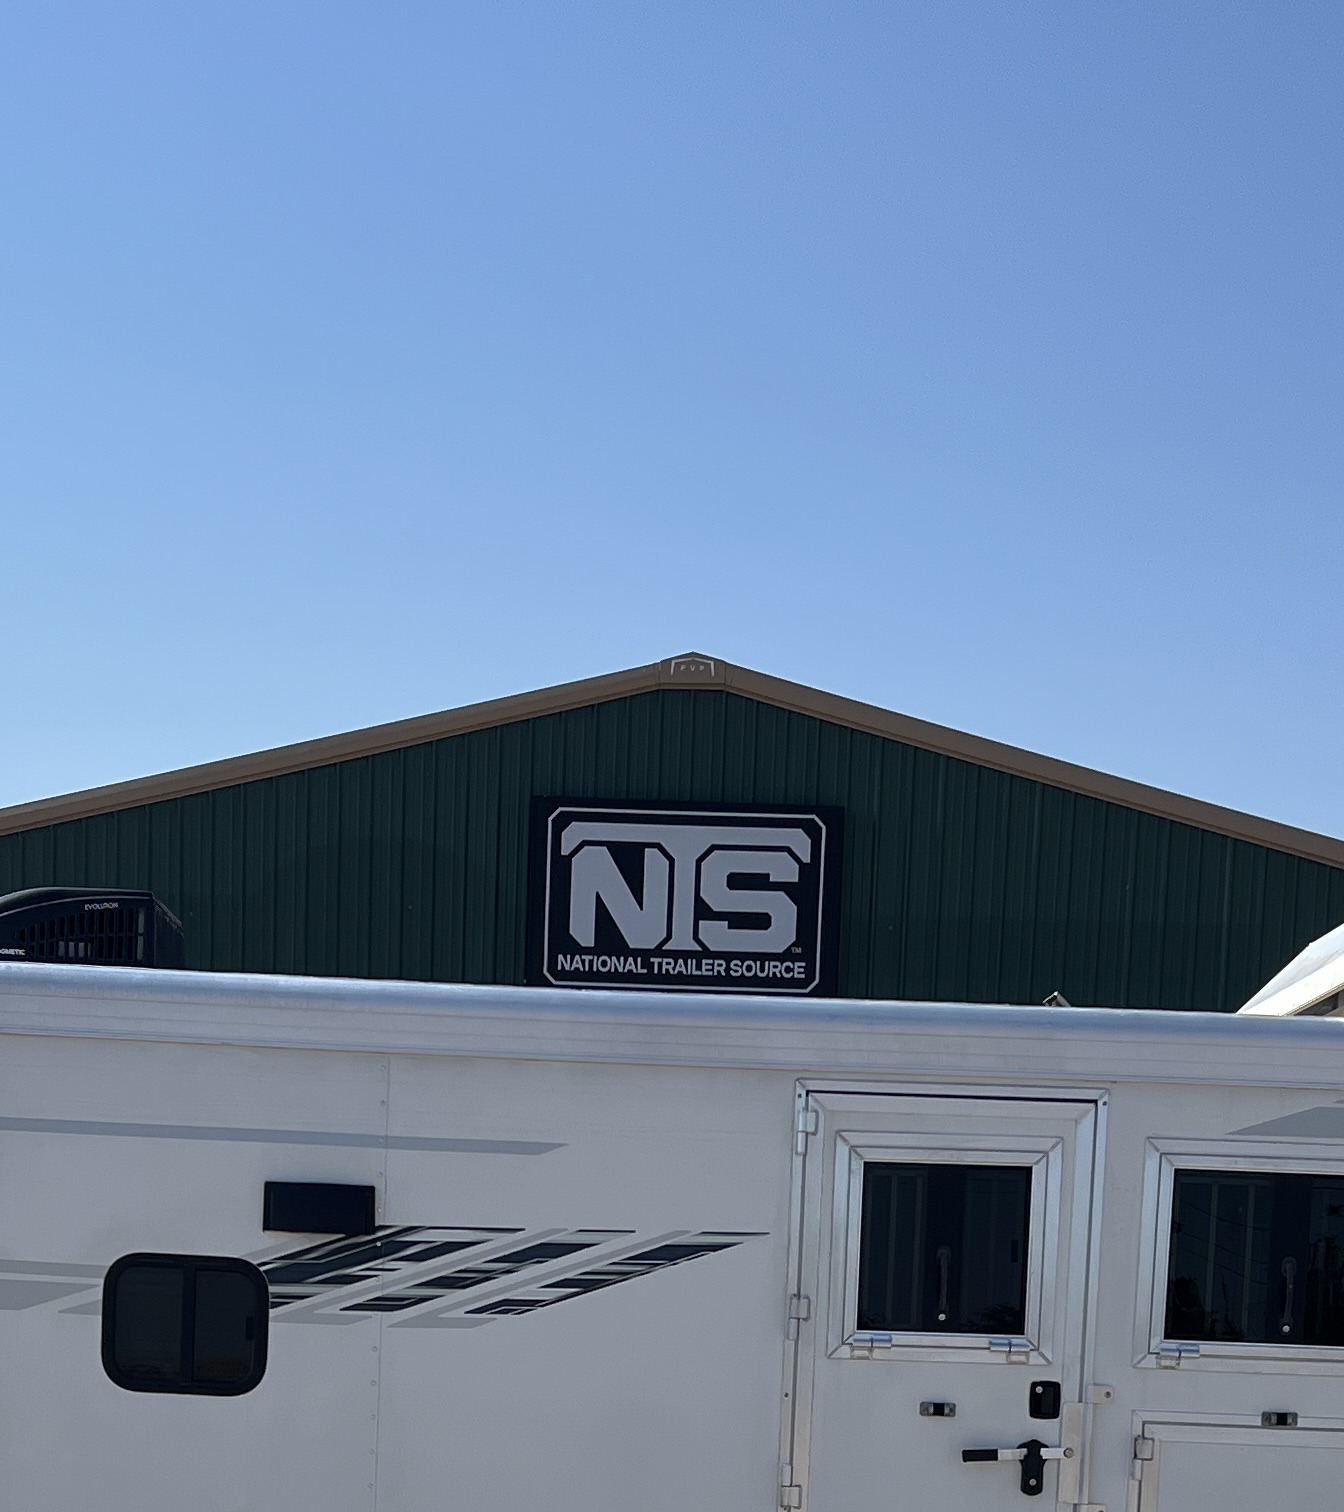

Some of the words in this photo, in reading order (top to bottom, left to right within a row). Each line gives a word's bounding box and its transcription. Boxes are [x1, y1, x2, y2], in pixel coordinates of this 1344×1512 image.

[560, 820, 812, 954] NTS
[556, 953, 648, 974] NATIONAL
[650, 957, 726, 977] TRAILER
[729, 959, 806, 979] SOURCE
